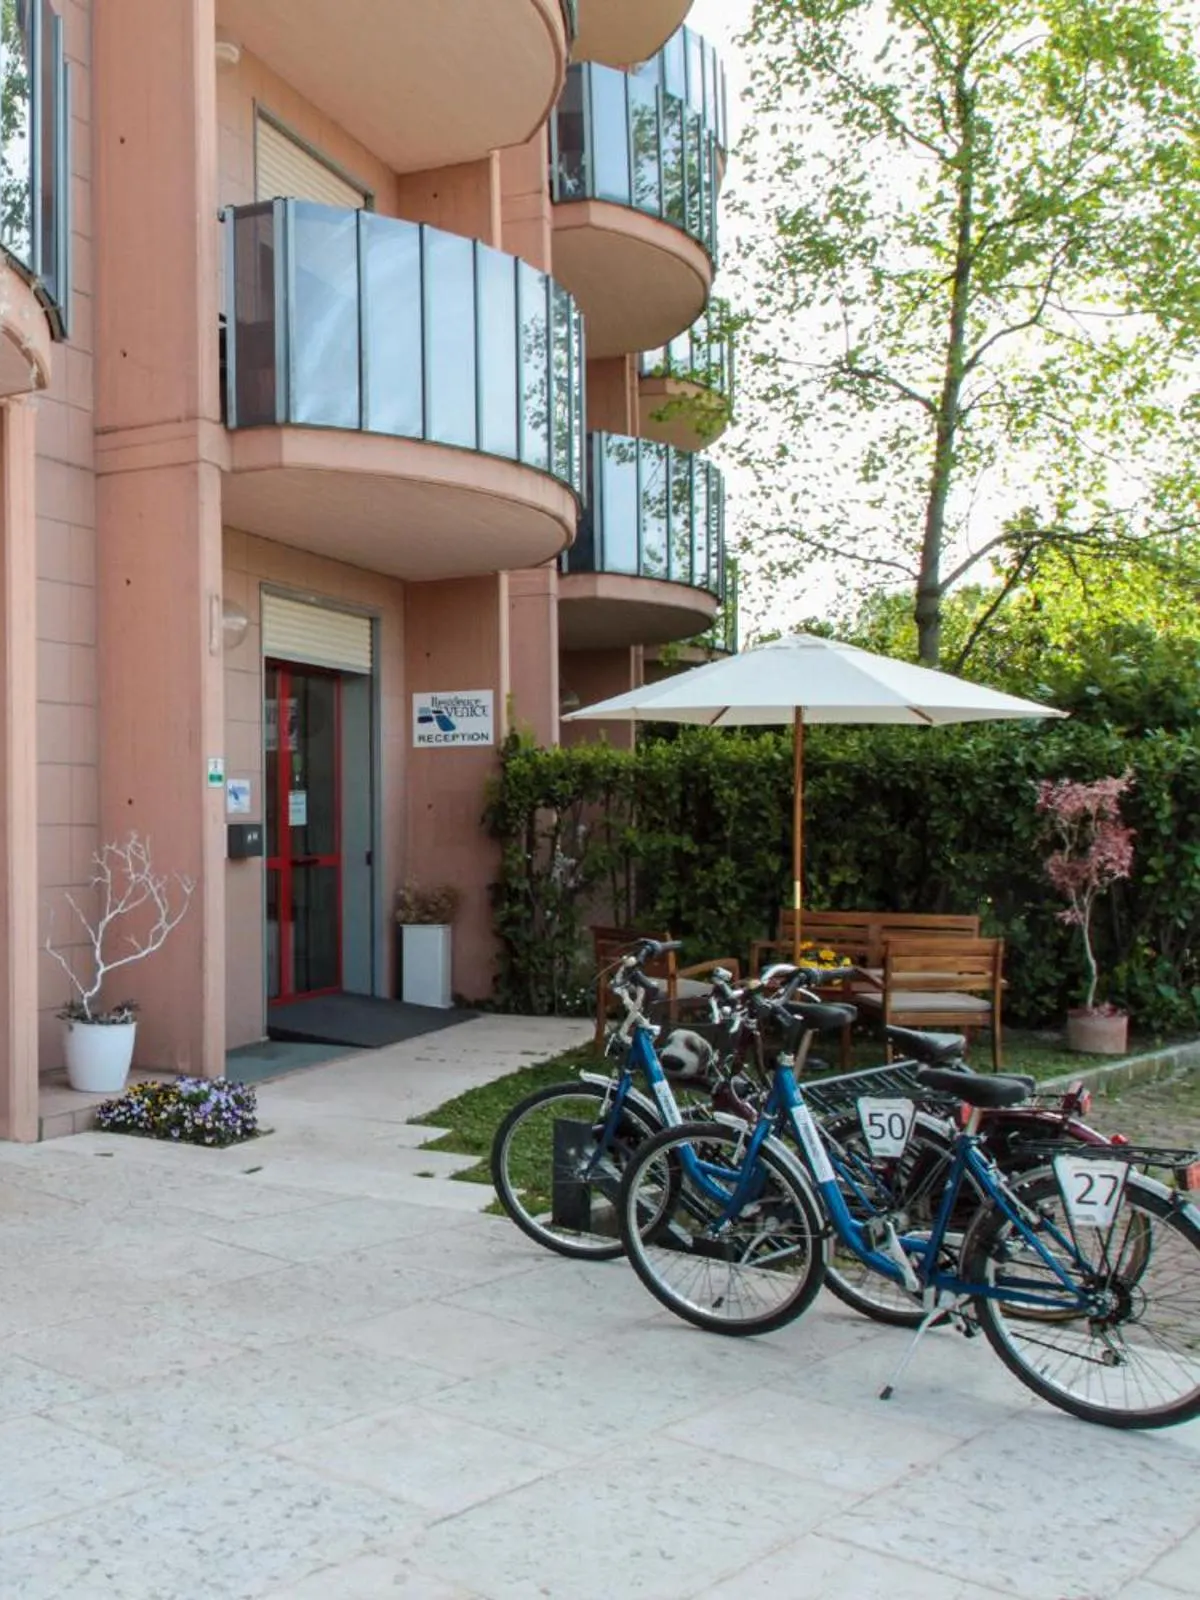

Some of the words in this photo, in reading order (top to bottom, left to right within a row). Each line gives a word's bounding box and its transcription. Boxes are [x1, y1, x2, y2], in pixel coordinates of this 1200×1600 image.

[418, 731, 489, 743] RECEPTION
[868, 1112, 906, 1140] 50
[1073, 1172, 1119, 1206] 27
